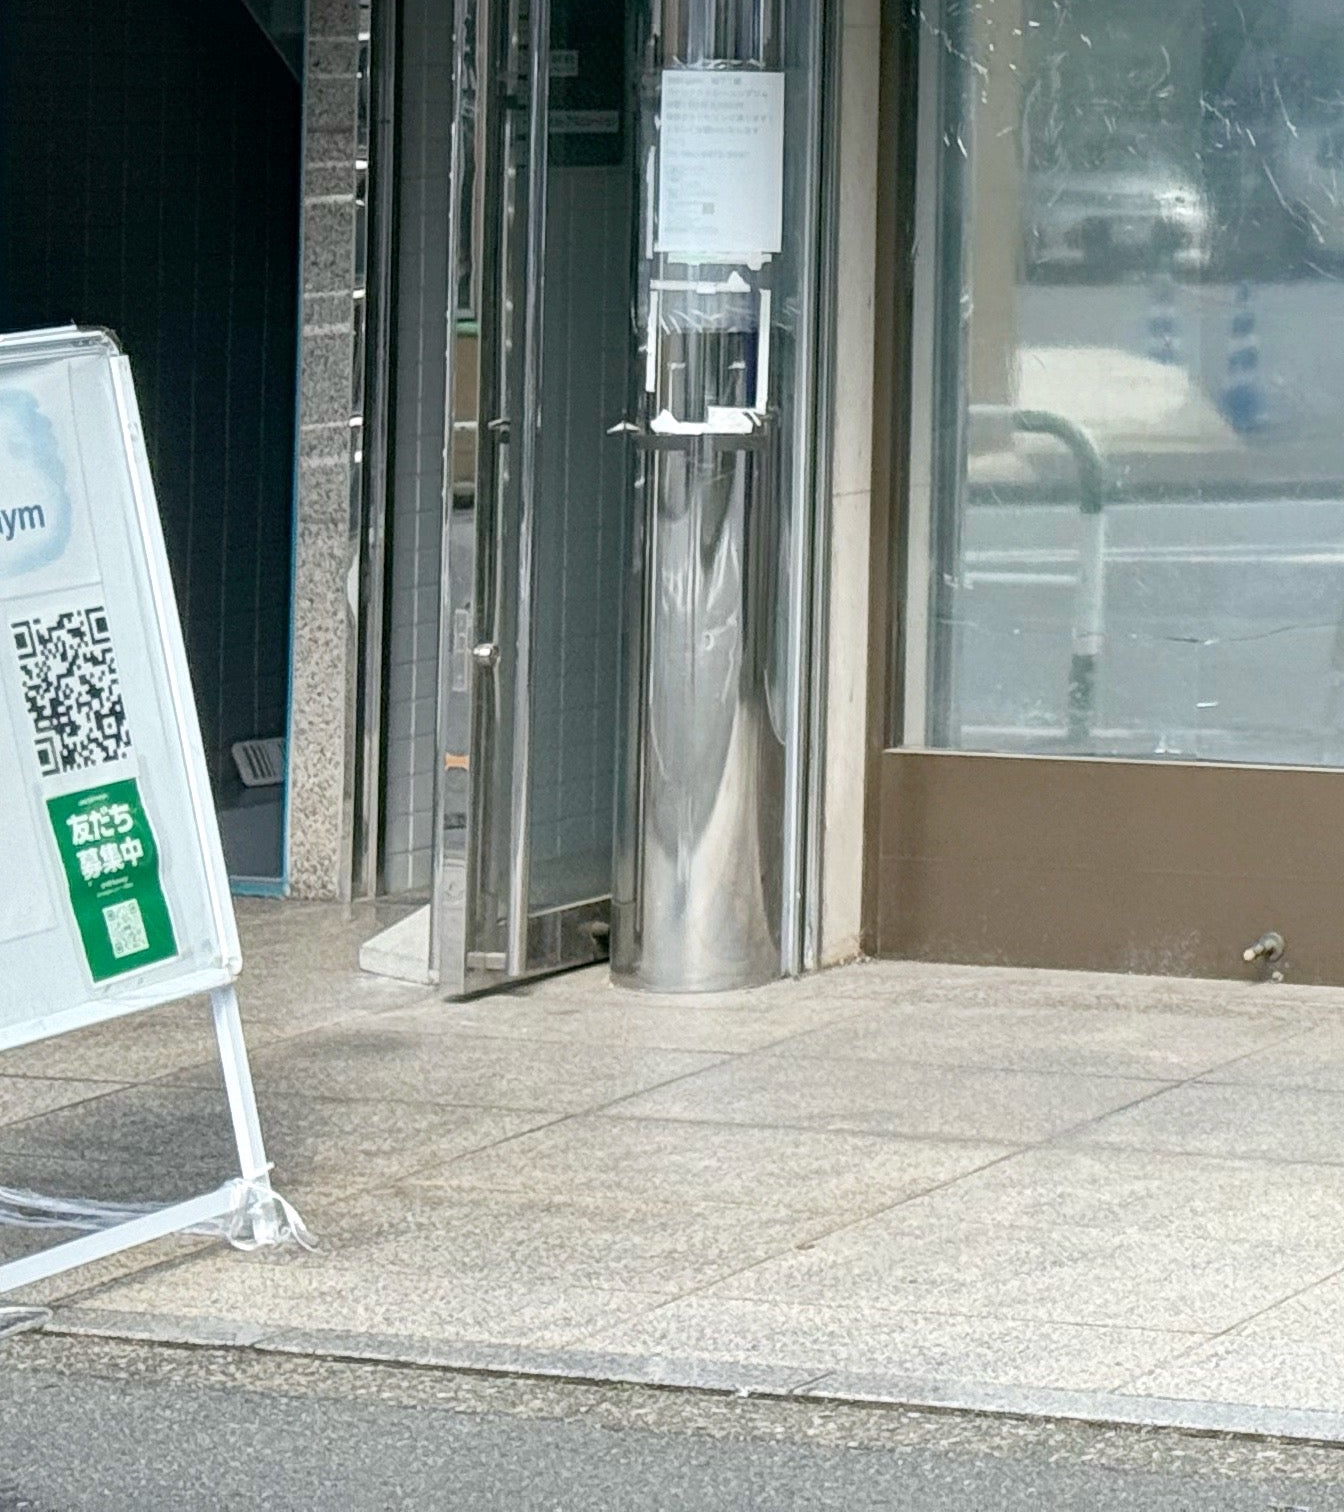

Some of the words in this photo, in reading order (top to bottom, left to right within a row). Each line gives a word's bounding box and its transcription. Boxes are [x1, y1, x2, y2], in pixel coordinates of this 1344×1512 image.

[0, 505, 46, 541] ym
[65, 803, 134, 846] 友だち
[75, 836, 145, 881] 募集中
